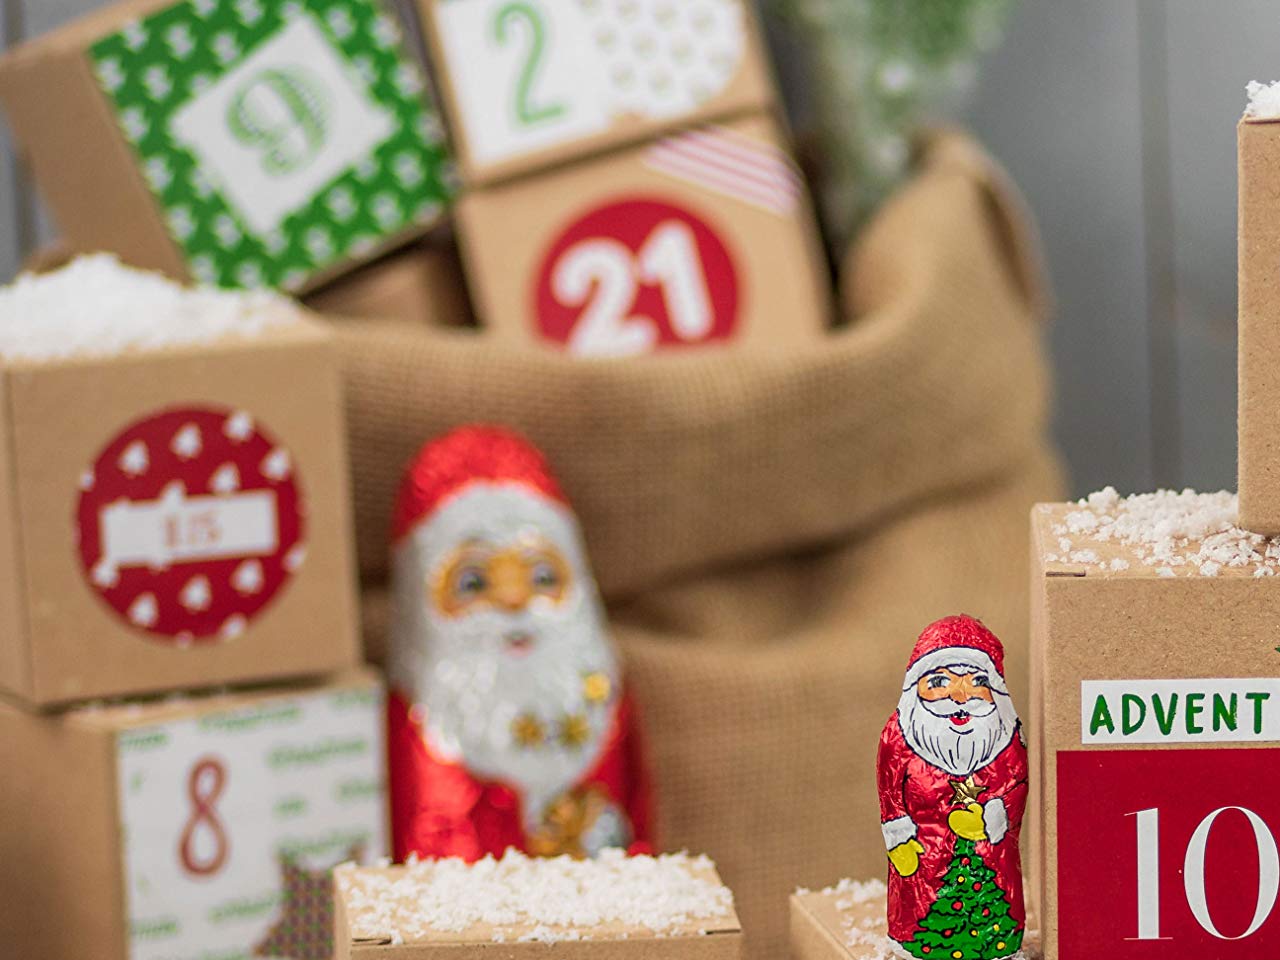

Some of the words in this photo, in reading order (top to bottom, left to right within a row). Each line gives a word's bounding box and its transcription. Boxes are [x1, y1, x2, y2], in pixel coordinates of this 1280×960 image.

[226, 70, 330, 174] 9
[493, 2, 571, 126] 2
[552, 219, 716, 356] 21
[1089, 692, 1271, 736] ADVENT
[178, 755, 230, 876] 8
[1123, 806, 1280, 940] 10
